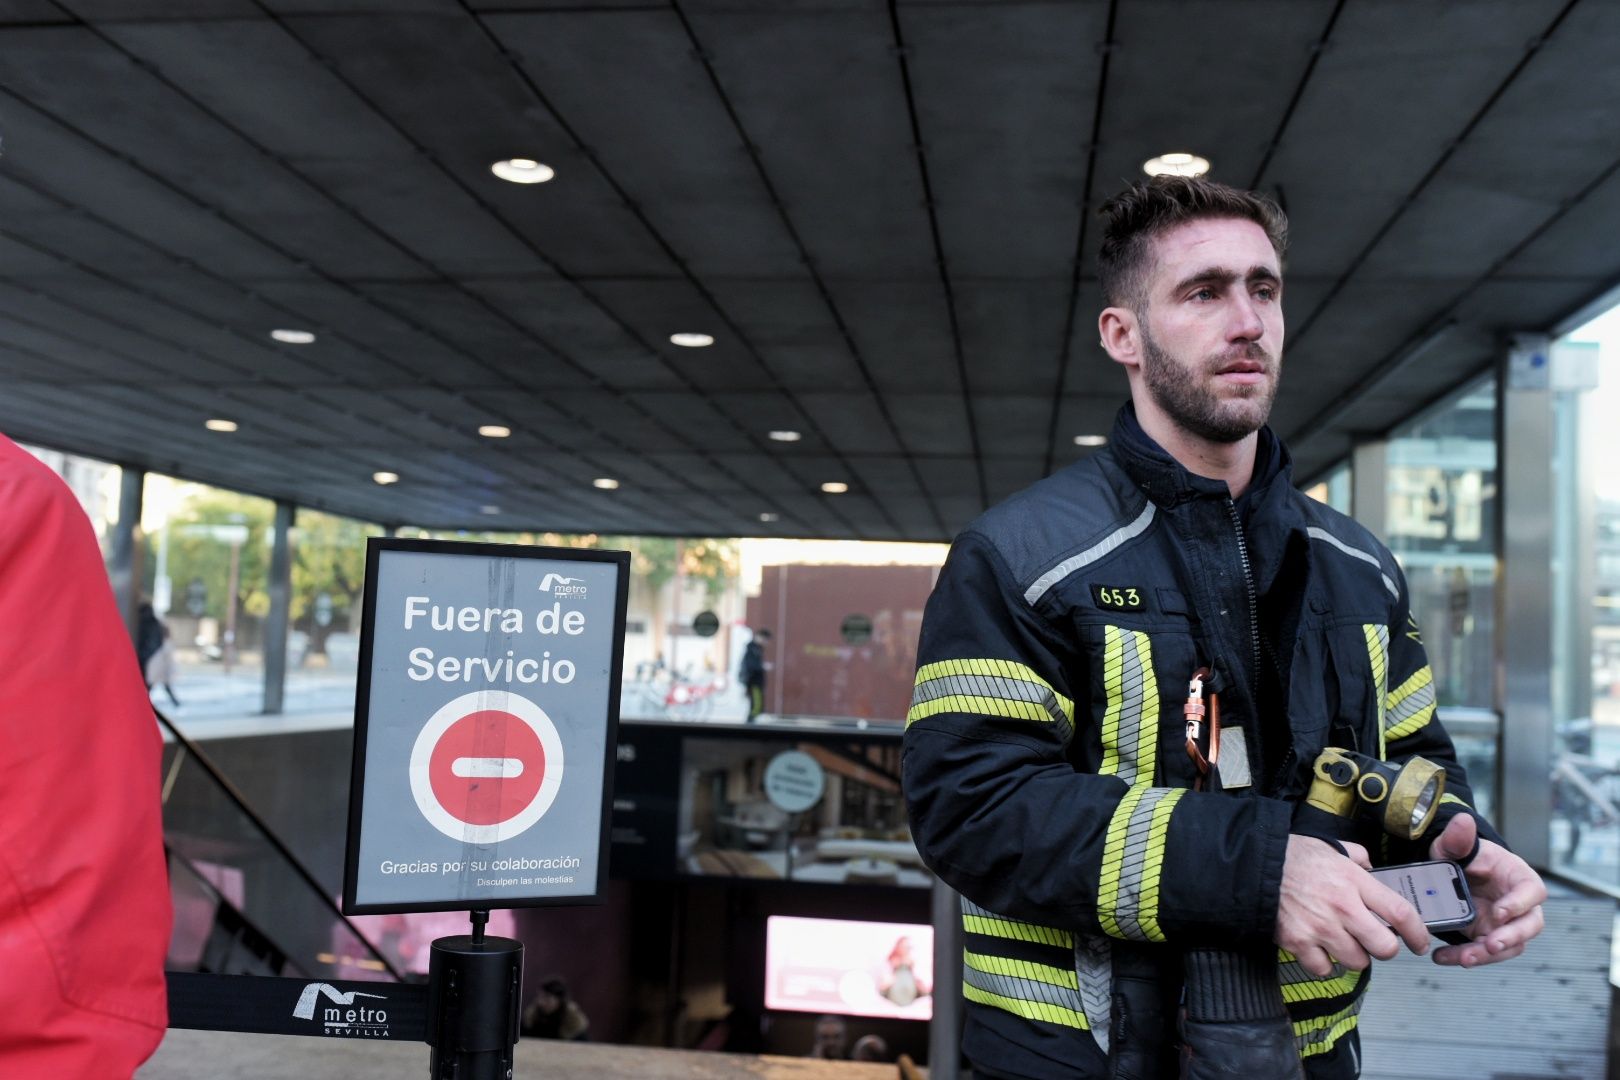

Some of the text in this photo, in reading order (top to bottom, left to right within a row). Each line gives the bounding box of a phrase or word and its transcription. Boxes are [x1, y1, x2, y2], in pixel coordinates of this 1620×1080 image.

[554, 585, 587, 593] metro
[1100, 587, 1140, 606] 653
[404, 596, 585, 635] Fuera de
[407, 647, 576, 684] Servicio
[380, 855, 580, 876] Gracias por su colaboración
[477, 876, 518, 888] Disculpen
[520, 876, 532, 885] las
[324, 1006, 387, 1022] metro
[324, 1028, 389, 1036] SEVILLA
